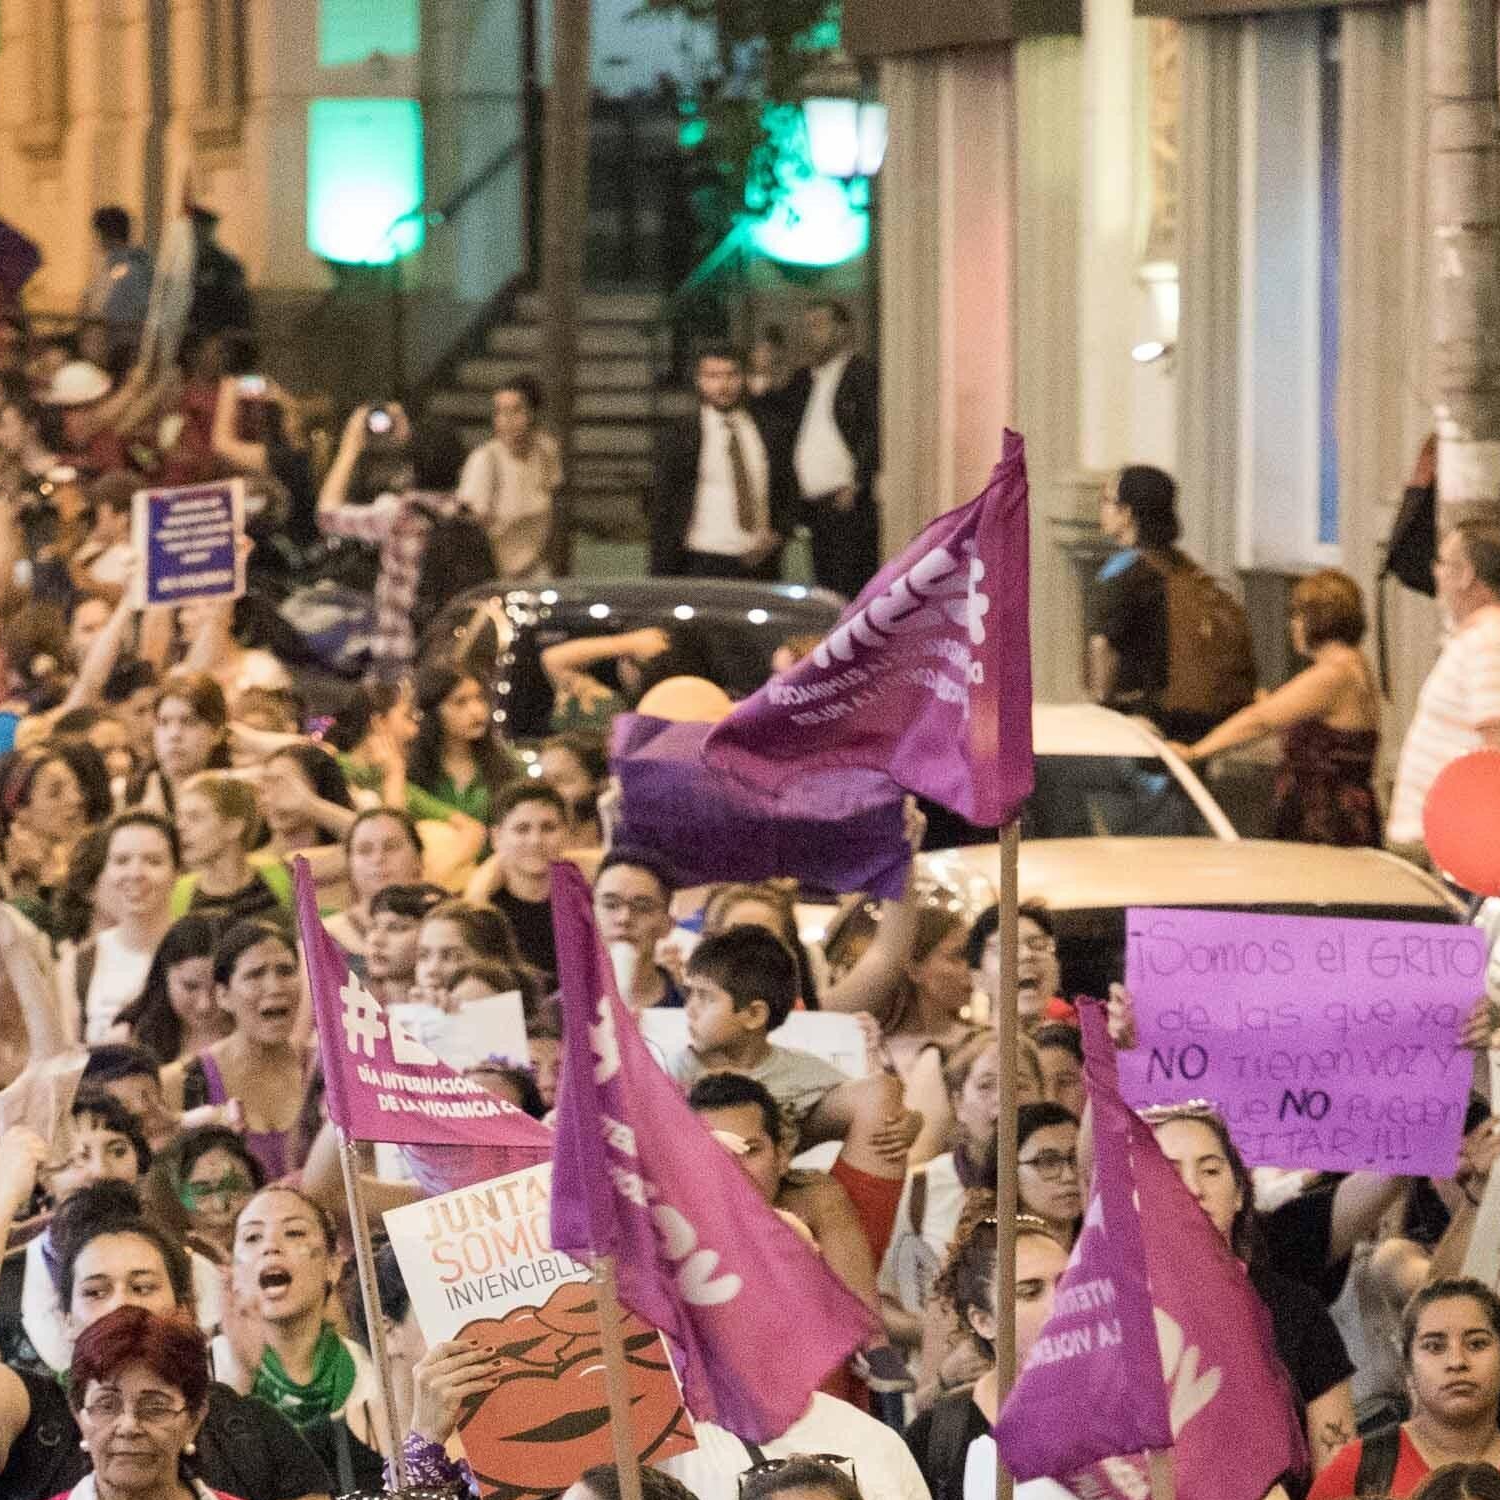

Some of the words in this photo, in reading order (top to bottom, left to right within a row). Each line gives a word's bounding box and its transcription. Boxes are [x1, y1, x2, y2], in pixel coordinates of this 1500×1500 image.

[1315, 932, 1347, 975] el
[1367, 934, 1484, 979] GRITO
[1156, 1002, 1211, 1033] de
[1236, 1001, 1302, 1032] las
[1323, 998, 1396, 1042] que
[1146, 1042, 1210, 1084] NO
[1277, 1086, 1333, 1123] NO
